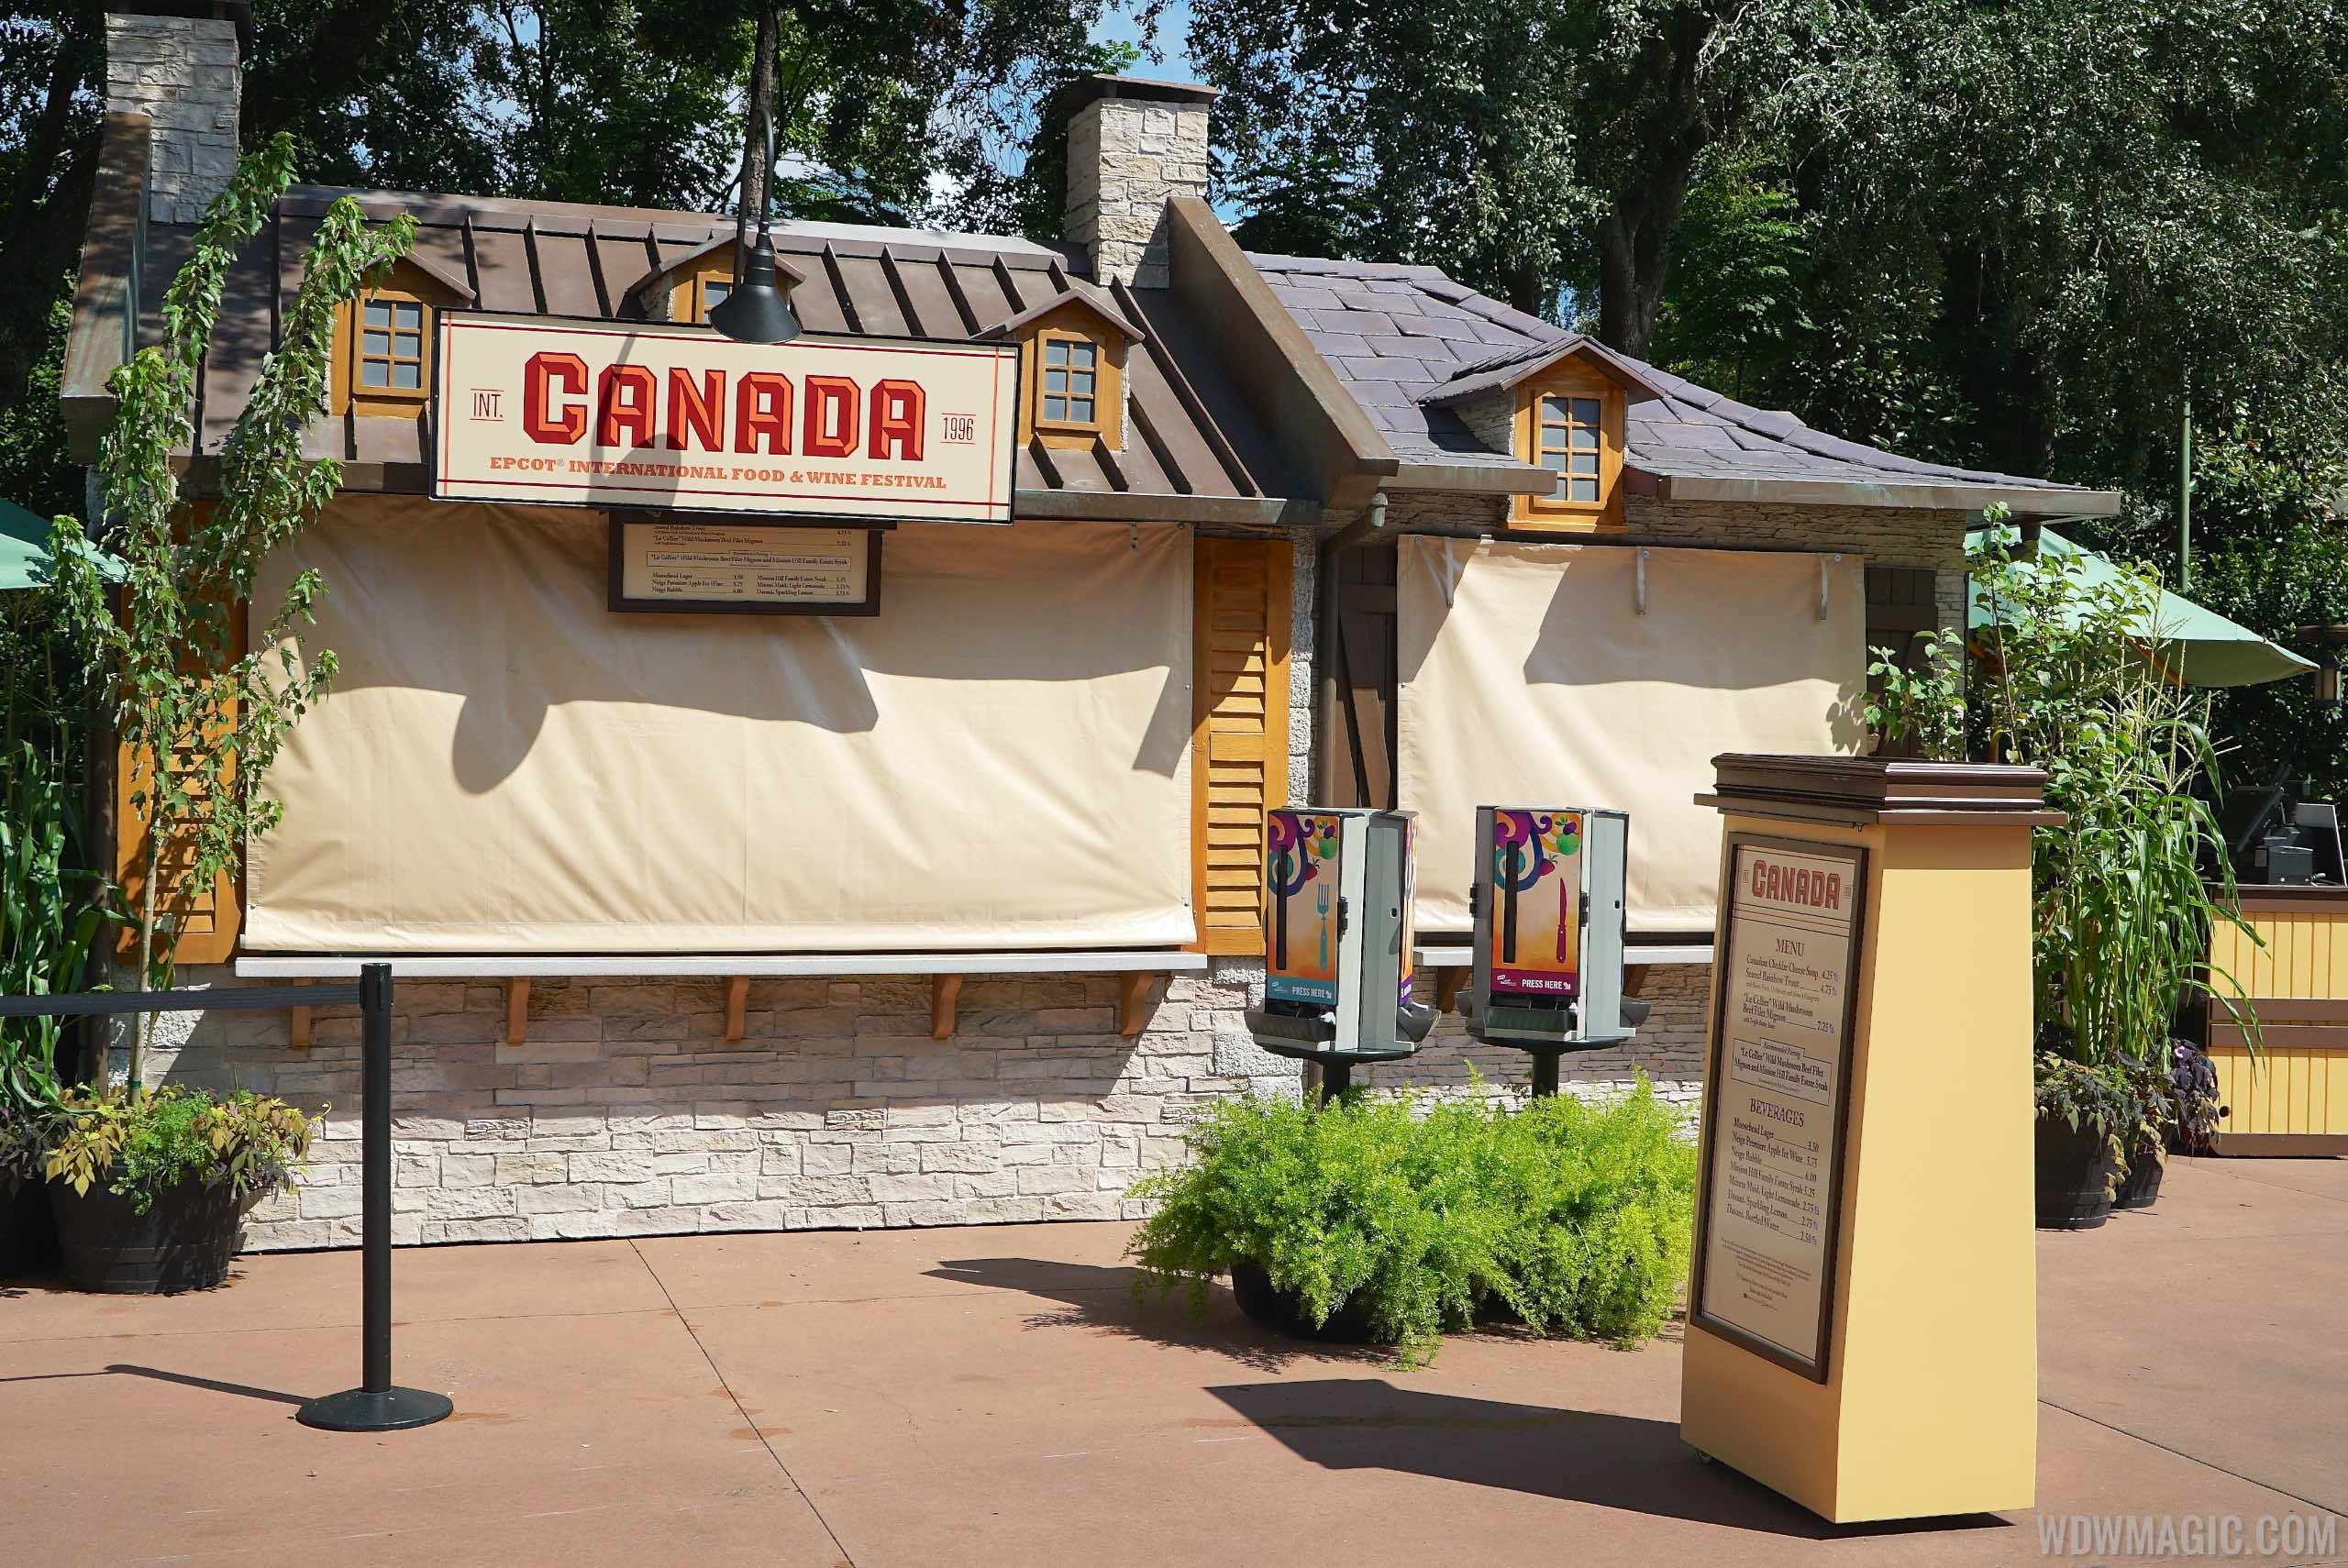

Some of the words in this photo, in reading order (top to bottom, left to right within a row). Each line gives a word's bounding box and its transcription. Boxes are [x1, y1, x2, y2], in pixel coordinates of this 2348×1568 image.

[472, 392, 503, 419] INT.
[523, 351, 926, 461] CANADA
[942, 414, 974, 442] 1996
[568, 460, 727, 481] INTERNATIONAL
[731, 468, 785, 483] FOOD
[790, 469, 803, 483] &
[806, 470, 857, 486] WINE
[860, 473, 947, 490] FESTIVAL
[1752, 859, 1841, 911] CANADA
[1776, 938, 1805, 957] MENU
[1762, 970, 1783, 984] Rainbow
[1785, 975, 1800, 988] Trout
[1768, 957, 1789, 971] Cheddar
[1789, 962, 1806, 975] Cheese
[1806, 966, 1819, 980] Soup
[1291, 986, 1310, 997] PRESS
[1311, 988, 1325, 999] HERE
[1522, 978, 1543, 988] PRESS
[1545, 980, 1562, 989] HERE
[1743, 1003, 1753, 1015] Beef
[1754, 1005, 1765, 1018] Filet
[1766, 1008, 1787, 1023] Mignon
[1772, 999, 1785, 1010] Wild
[1786, 1000, 1812, 1017] Mushroom
[1734, 1056, 1751, 1071] Mignon
[1751, 1062, 1759, 1072] and
[1786, 1070, 1800, 1084] Family
[1815, 1078, 1828, 1092] Syrah
[1766, 1053, 1777, 1065] Wild
[1777, 1055, 1801, 1072] Mushroom
[1801, 1062, 1812, 1075] Beef
[1812, 1064, 1824, 1077] Filet
[1750, 1098, 1804, 1127] BEVERAGES
[1733, 1116, 1760, 1134] Moosehead
[1761, 1124, 1774, 1141] Lager
[1745, 1151, 1761, 1165] Bubble
[1767, 1143, 1781, 1157] Apple
[1781, 1148, 1789, 1159] Ice
[1789, 1149, 1802, 1163] Wine
[1761, 1185, 1774, 1199] Light
[1775, 1191, 1800, 1209] Lemonade
[1789, 1180, 1803, 1196] Syrah
[1746, 1196, 1770, 1215] Sparkling
[1770, 1204, 1789, 1220] Lemon
[1745, 1209, 1763, 1226] Bottled
[1764, 1216, 1779, 1231] Water
